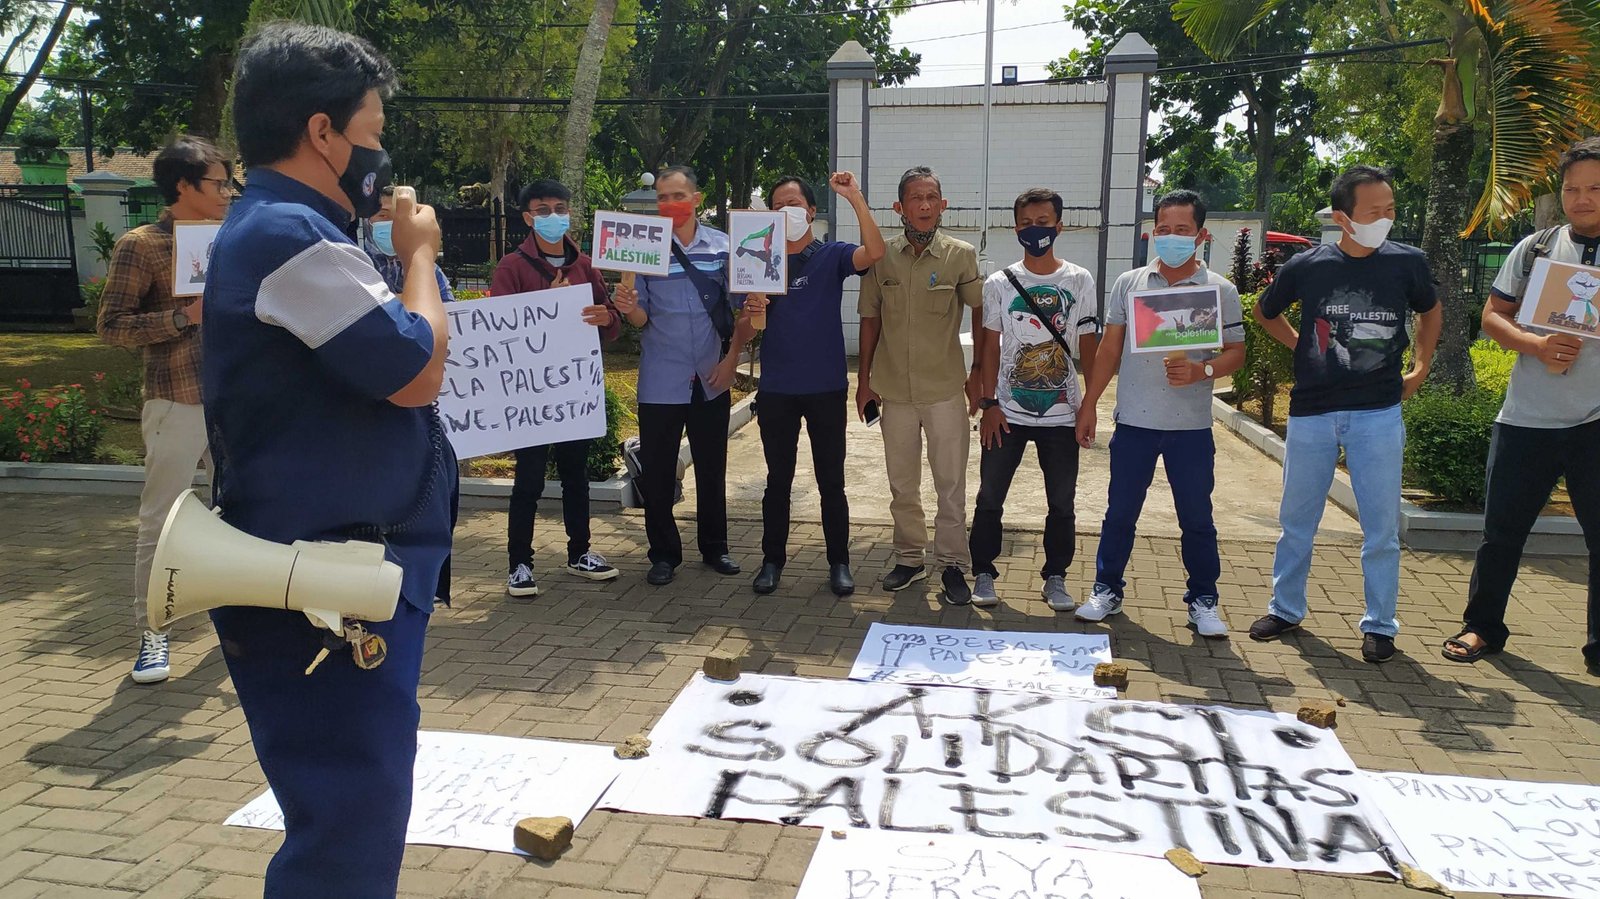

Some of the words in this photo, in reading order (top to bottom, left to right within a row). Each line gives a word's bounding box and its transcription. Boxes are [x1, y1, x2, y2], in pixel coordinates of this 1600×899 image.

[600, 221, 664, 248] FREE
[599, 247, 661, 266] PALESTINE
[448, 301, 559, 337] TAWAN
[1325, 304, 1350, 315] FREE
[825, 686, 1247, 764] AKSI
[703, 768, 1400, 873] PALESTINA
[887, 845, 1093, 891] SAYA
